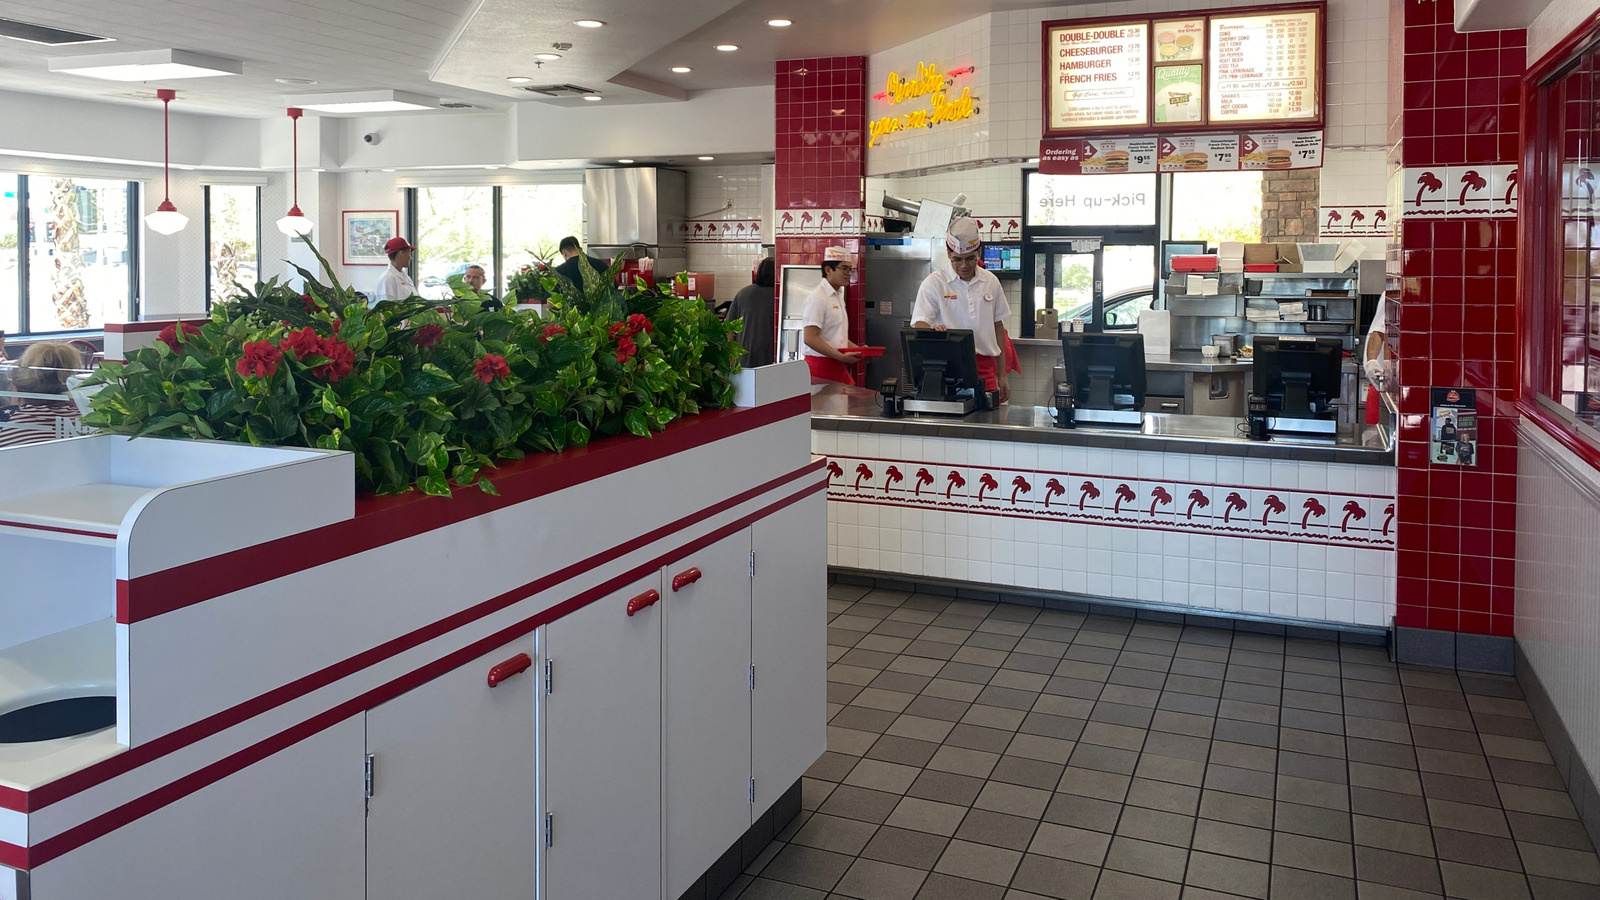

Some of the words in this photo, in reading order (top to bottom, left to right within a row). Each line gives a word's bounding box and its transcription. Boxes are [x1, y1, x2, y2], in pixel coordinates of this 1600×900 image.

[1060, 29, 1125, 42] DOUBLE-DOUBLE
[1060, 45, 1123, 58] CHEESEBURGER
[1060, 59, 1112, 70] HAMBURGER
[1060, 74, 1092, 84] FRENCH
[1094, 73, 1118, 82] FRIES
[1158, 67, 1190, 80] Quality
[1084, 146, 1092, 155] 1
[1162, 143, 1171, 152] 2
[1244, 140, 1253, 150] 3
